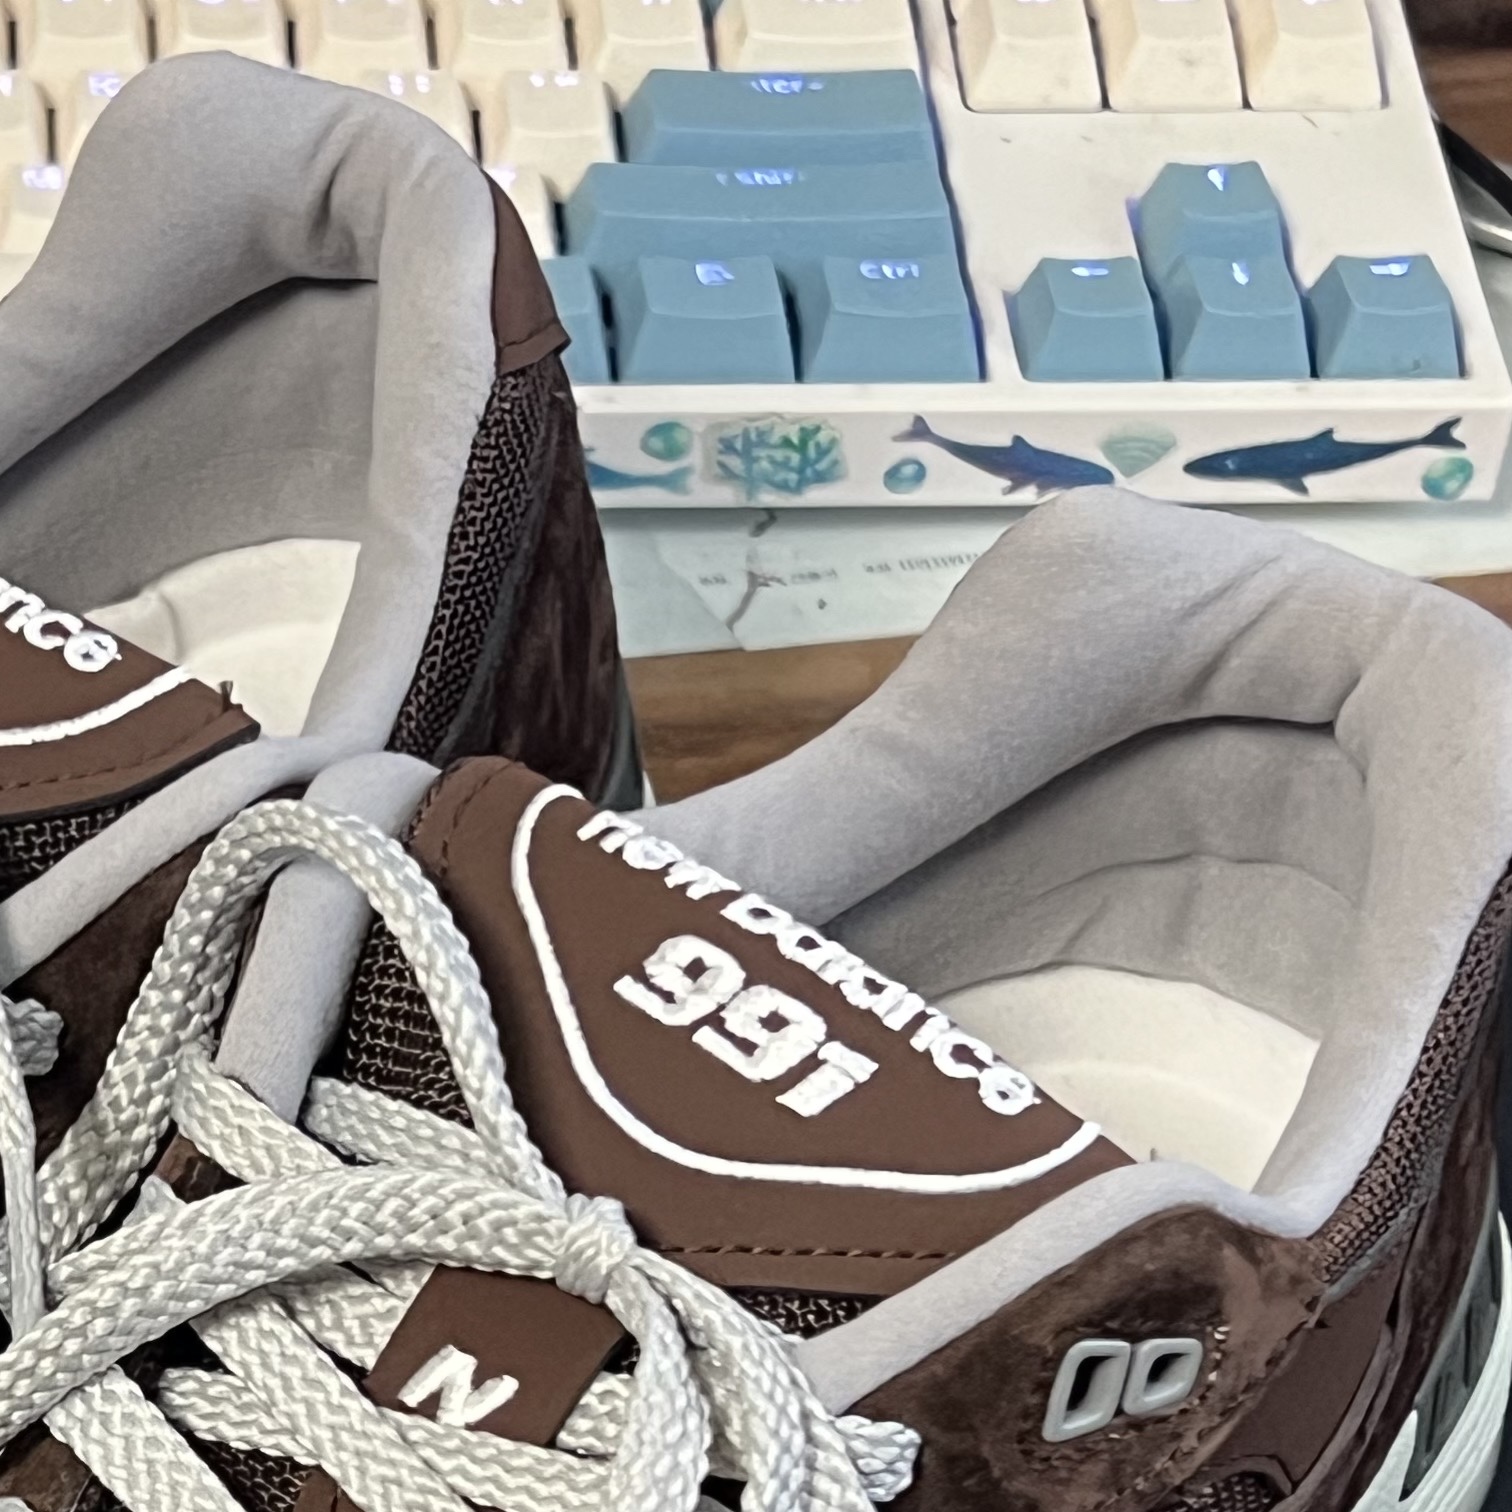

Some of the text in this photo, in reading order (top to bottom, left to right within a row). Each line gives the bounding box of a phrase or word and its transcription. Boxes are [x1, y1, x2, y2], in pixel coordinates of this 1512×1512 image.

[576, 809, 1041, 1116] new balance
[613, 934, 879, 1118] 991
